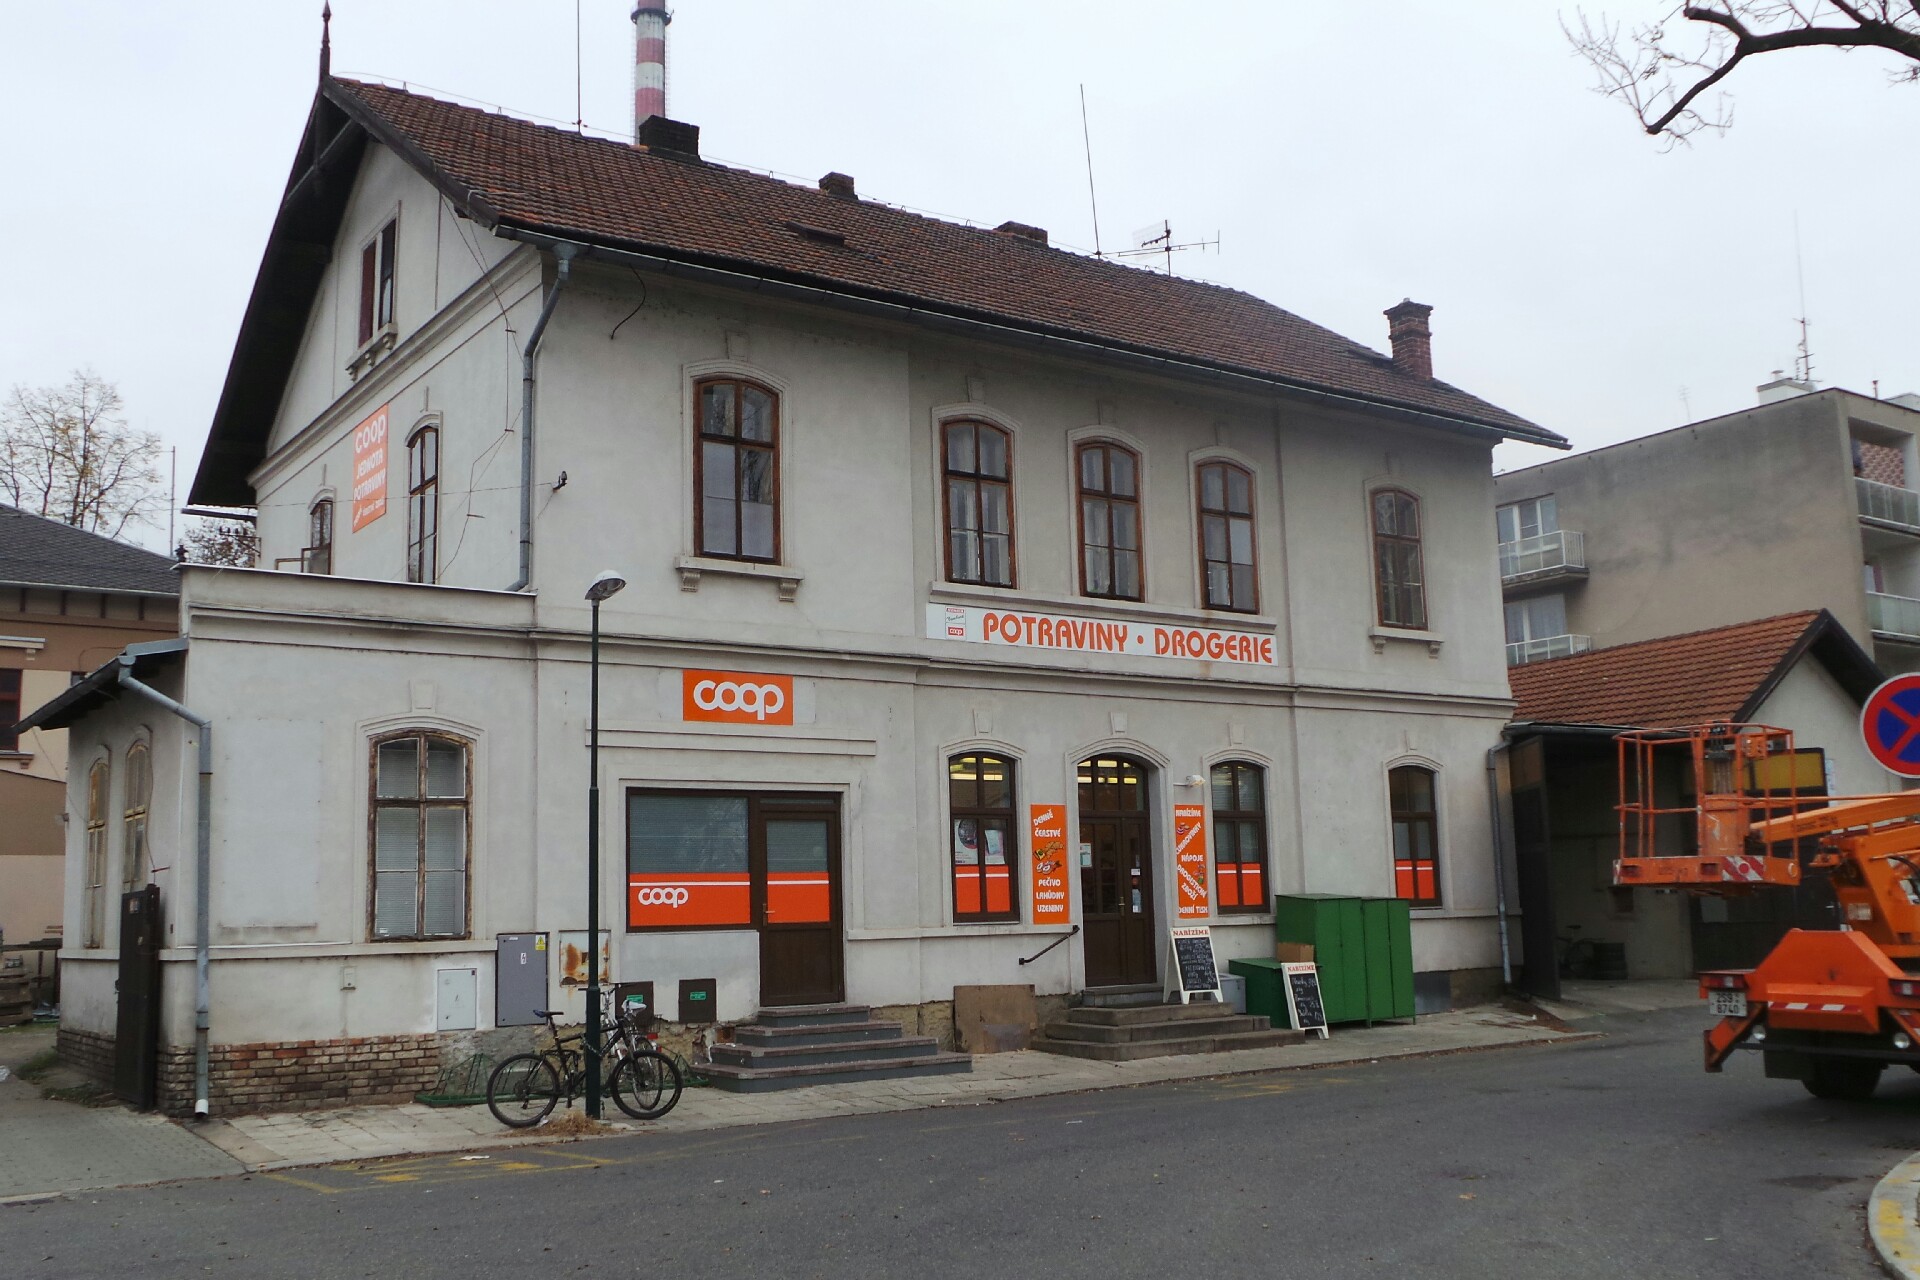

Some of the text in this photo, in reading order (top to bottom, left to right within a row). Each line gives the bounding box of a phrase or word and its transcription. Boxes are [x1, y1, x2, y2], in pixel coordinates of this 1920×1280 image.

[982, 612, 1272, 664] POTRAVINY DROGERIE
[693, 680, 785, 721] coop
[1038, 876, 1061, 887] PEČIVO
[638, 887, 689, 909] coop
[1037, 904, 1064, 913] UZENINY
